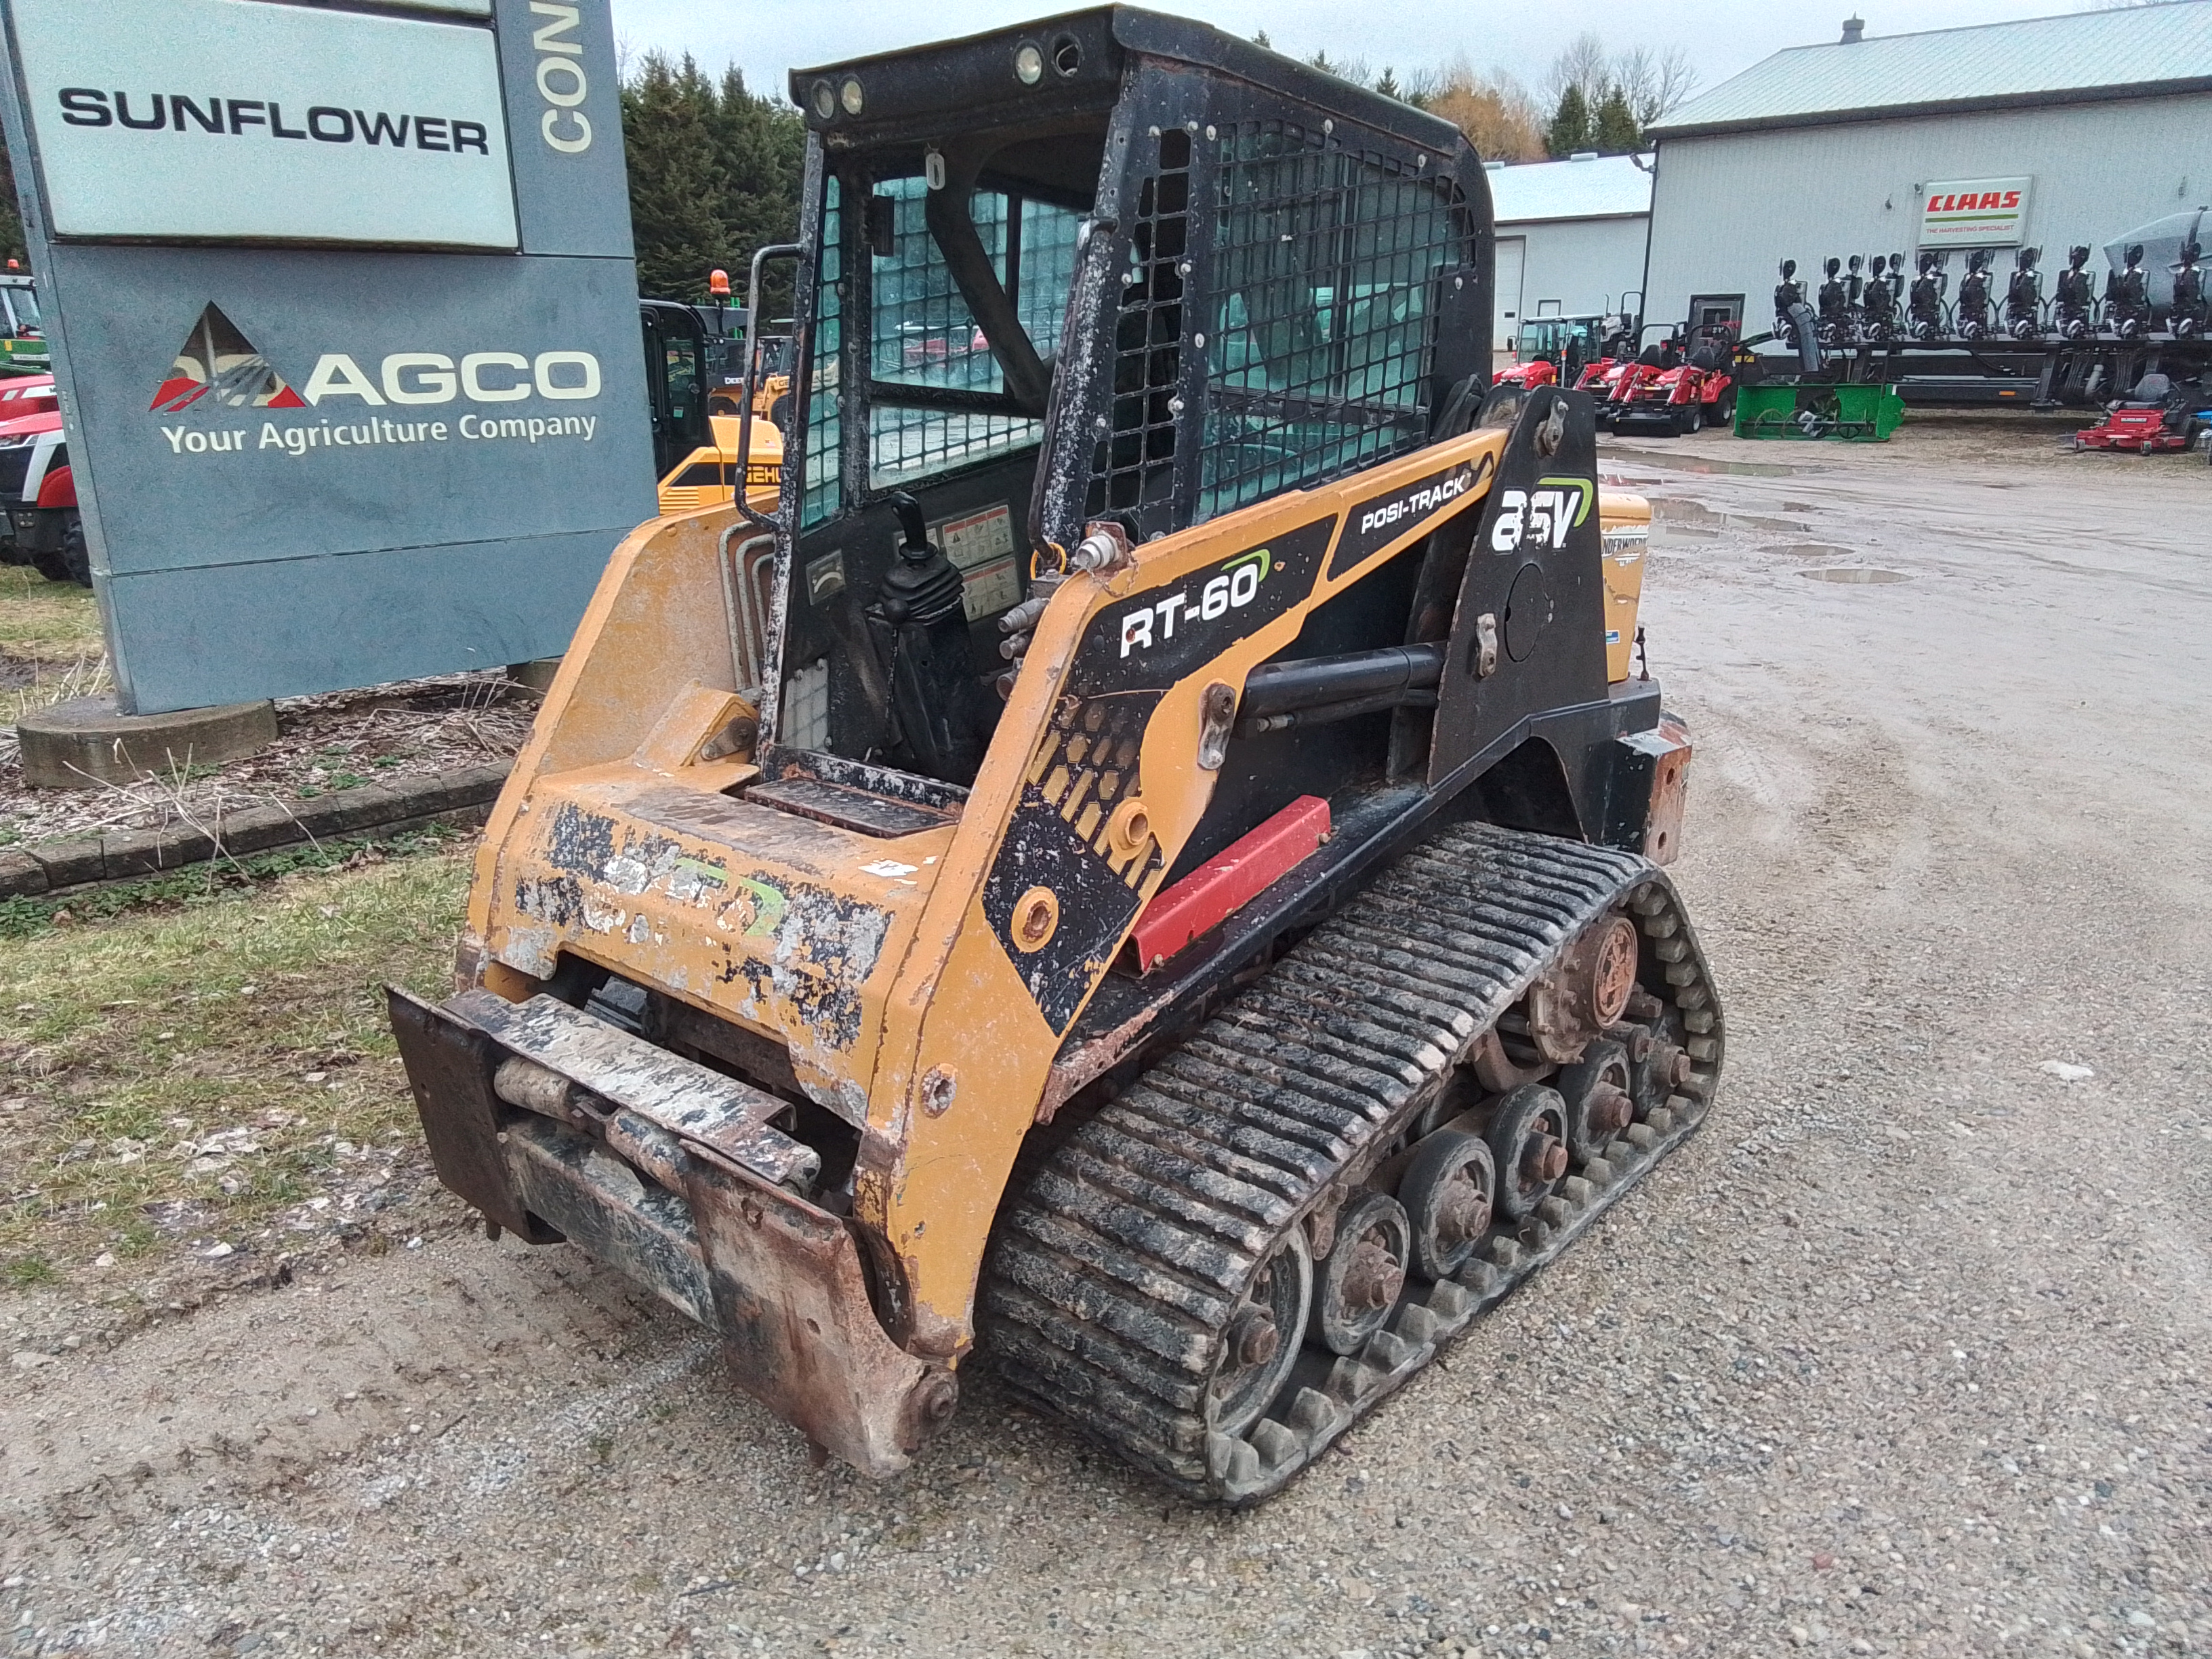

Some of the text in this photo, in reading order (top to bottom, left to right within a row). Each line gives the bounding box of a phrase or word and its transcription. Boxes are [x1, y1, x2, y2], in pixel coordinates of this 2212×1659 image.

[58, 87, 489, 155] SUNFLOWER
[1927, 191, 2022, 212] CLAAS
[303, 351, 601, 407] AGCO
[161, 413, 597, 455] Your Agriculture Company
[1360, 474, 1468, 535] POSI-TRACK
[1120, 563, 1258, 659] RT-60
